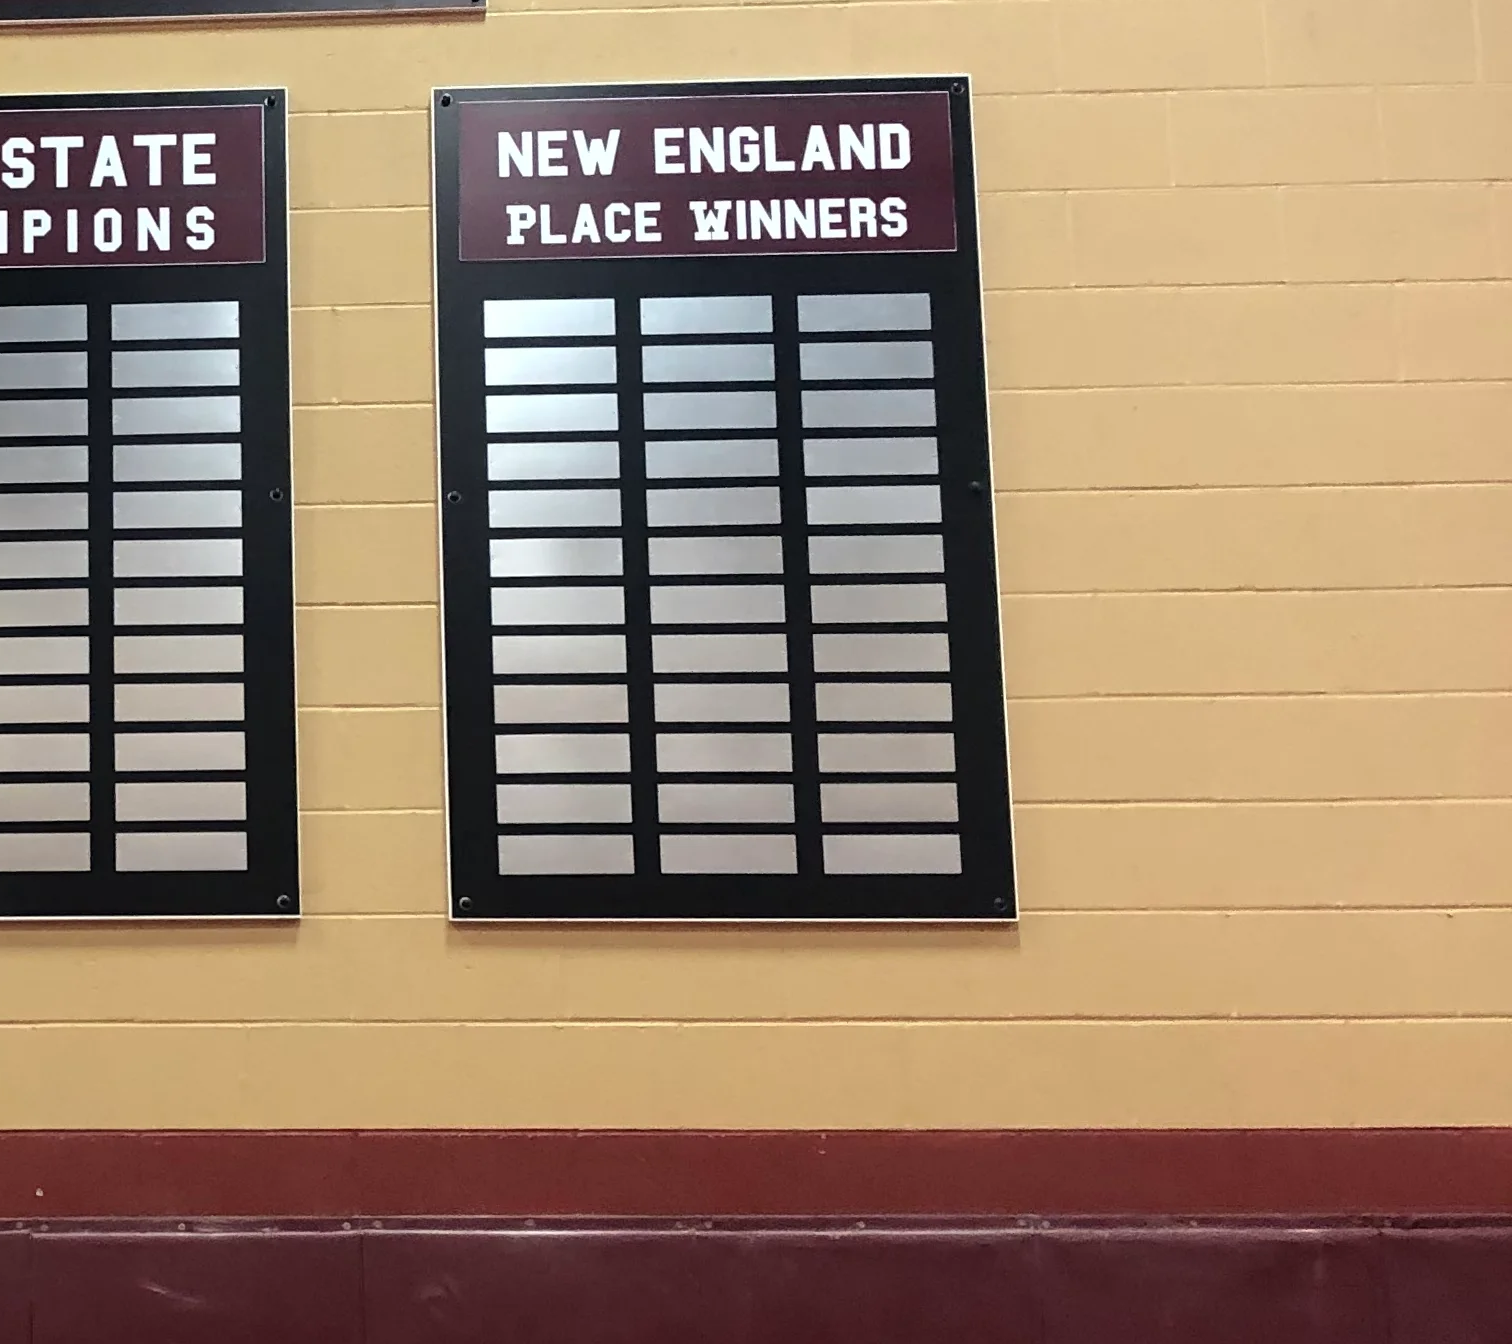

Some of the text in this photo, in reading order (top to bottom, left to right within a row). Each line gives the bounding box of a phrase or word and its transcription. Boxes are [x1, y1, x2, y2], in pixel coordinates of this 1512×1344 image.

[1, 132, 217, 189] STATE
[497, 123, 911, 178] NEW ENGLAND
[505, 196, 908, 245] PLACE WINNERS
